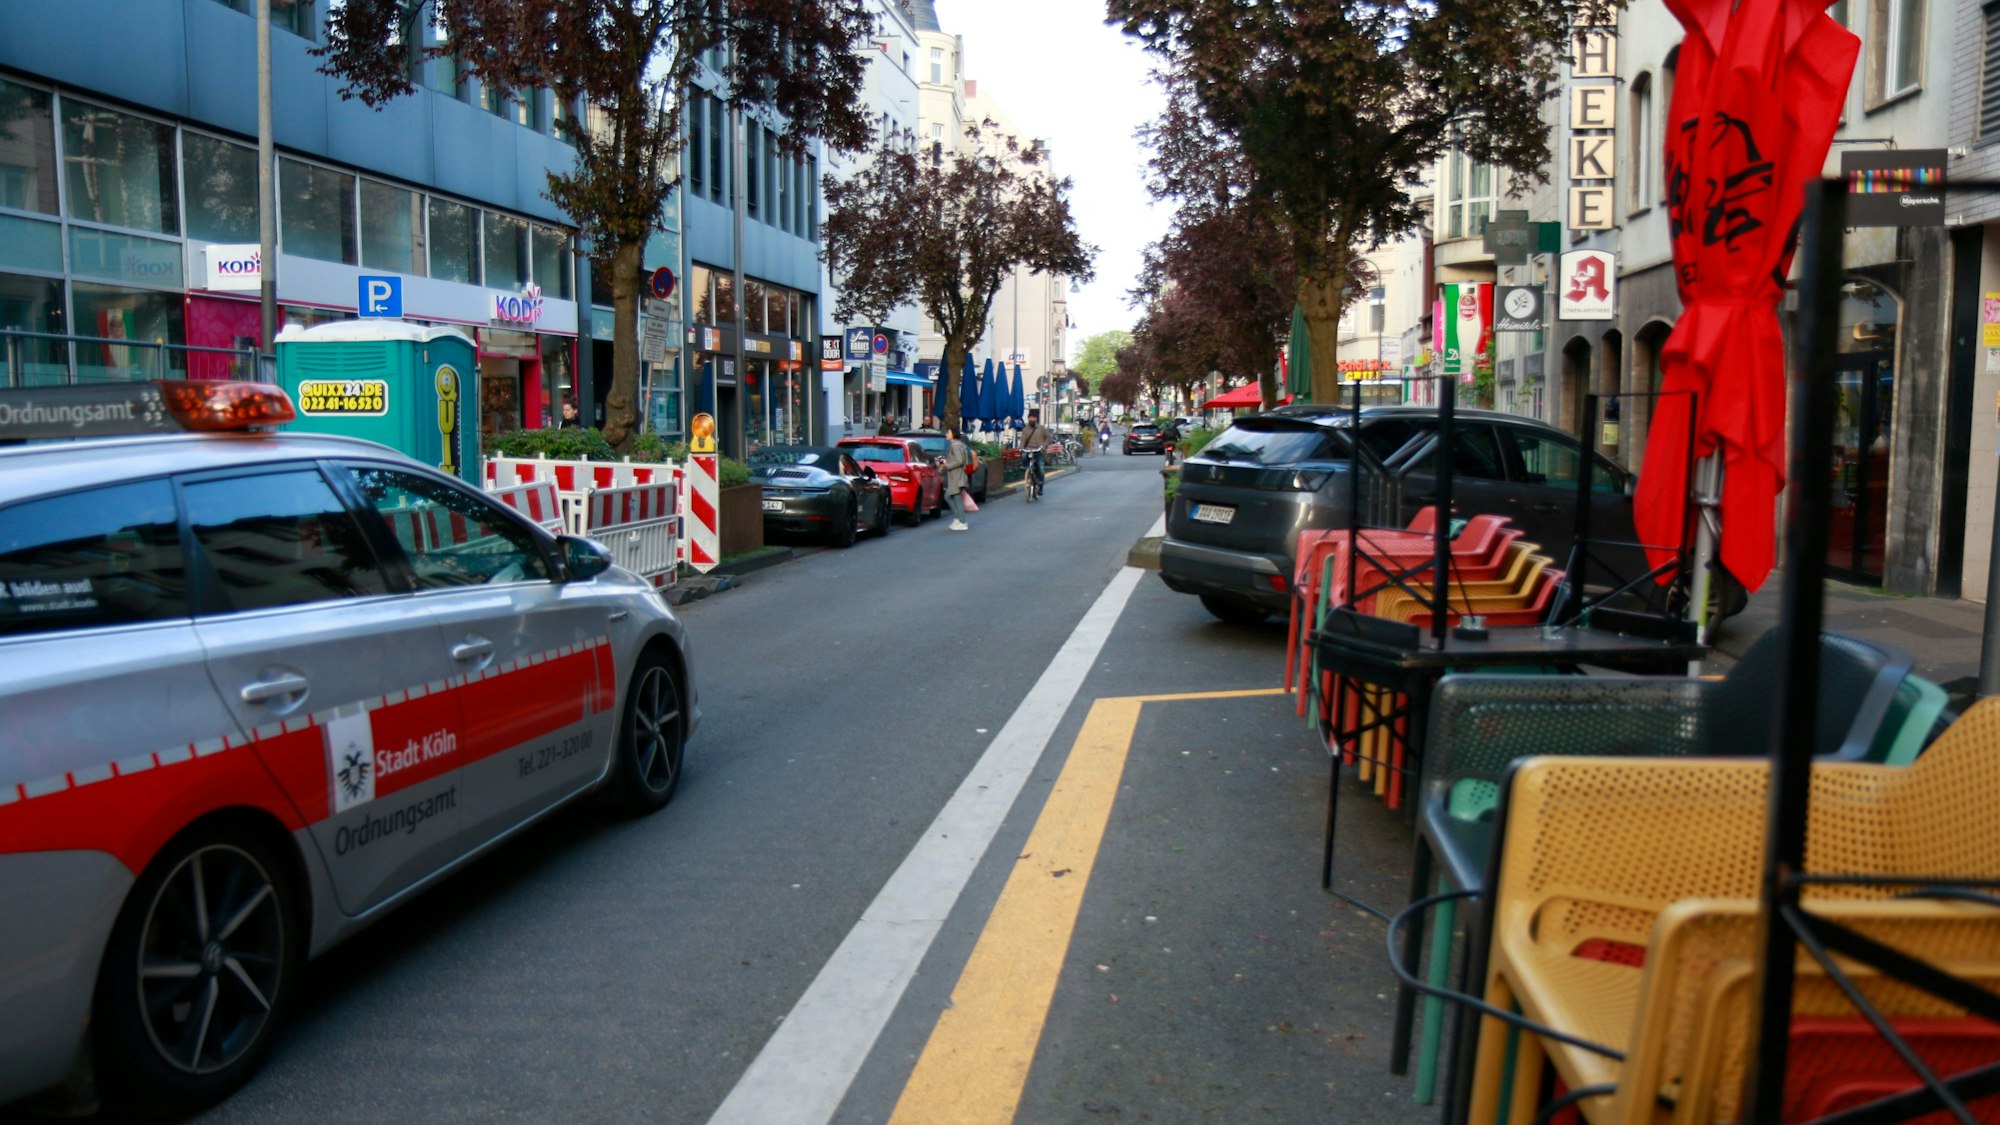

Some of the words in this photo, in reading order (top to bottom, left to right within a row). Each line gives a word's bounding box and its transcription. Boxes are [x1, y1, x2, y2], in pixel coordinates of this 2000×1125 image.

[368, 280, 392, 313] P
[823, 339, 841, 349] NEXT
[823, 350, 841, 359] DOOR
[302, 383, 383, 397] QUIXX24.DE
[0, 400, 135, 427] Ordnungsamt
[376, 739, 420, 777] Stadt
[423, 728, 457, 759] Köln
[518, 753, 536, 778] Tel.
[335, 784, 457, 857] Ordnungsamt
